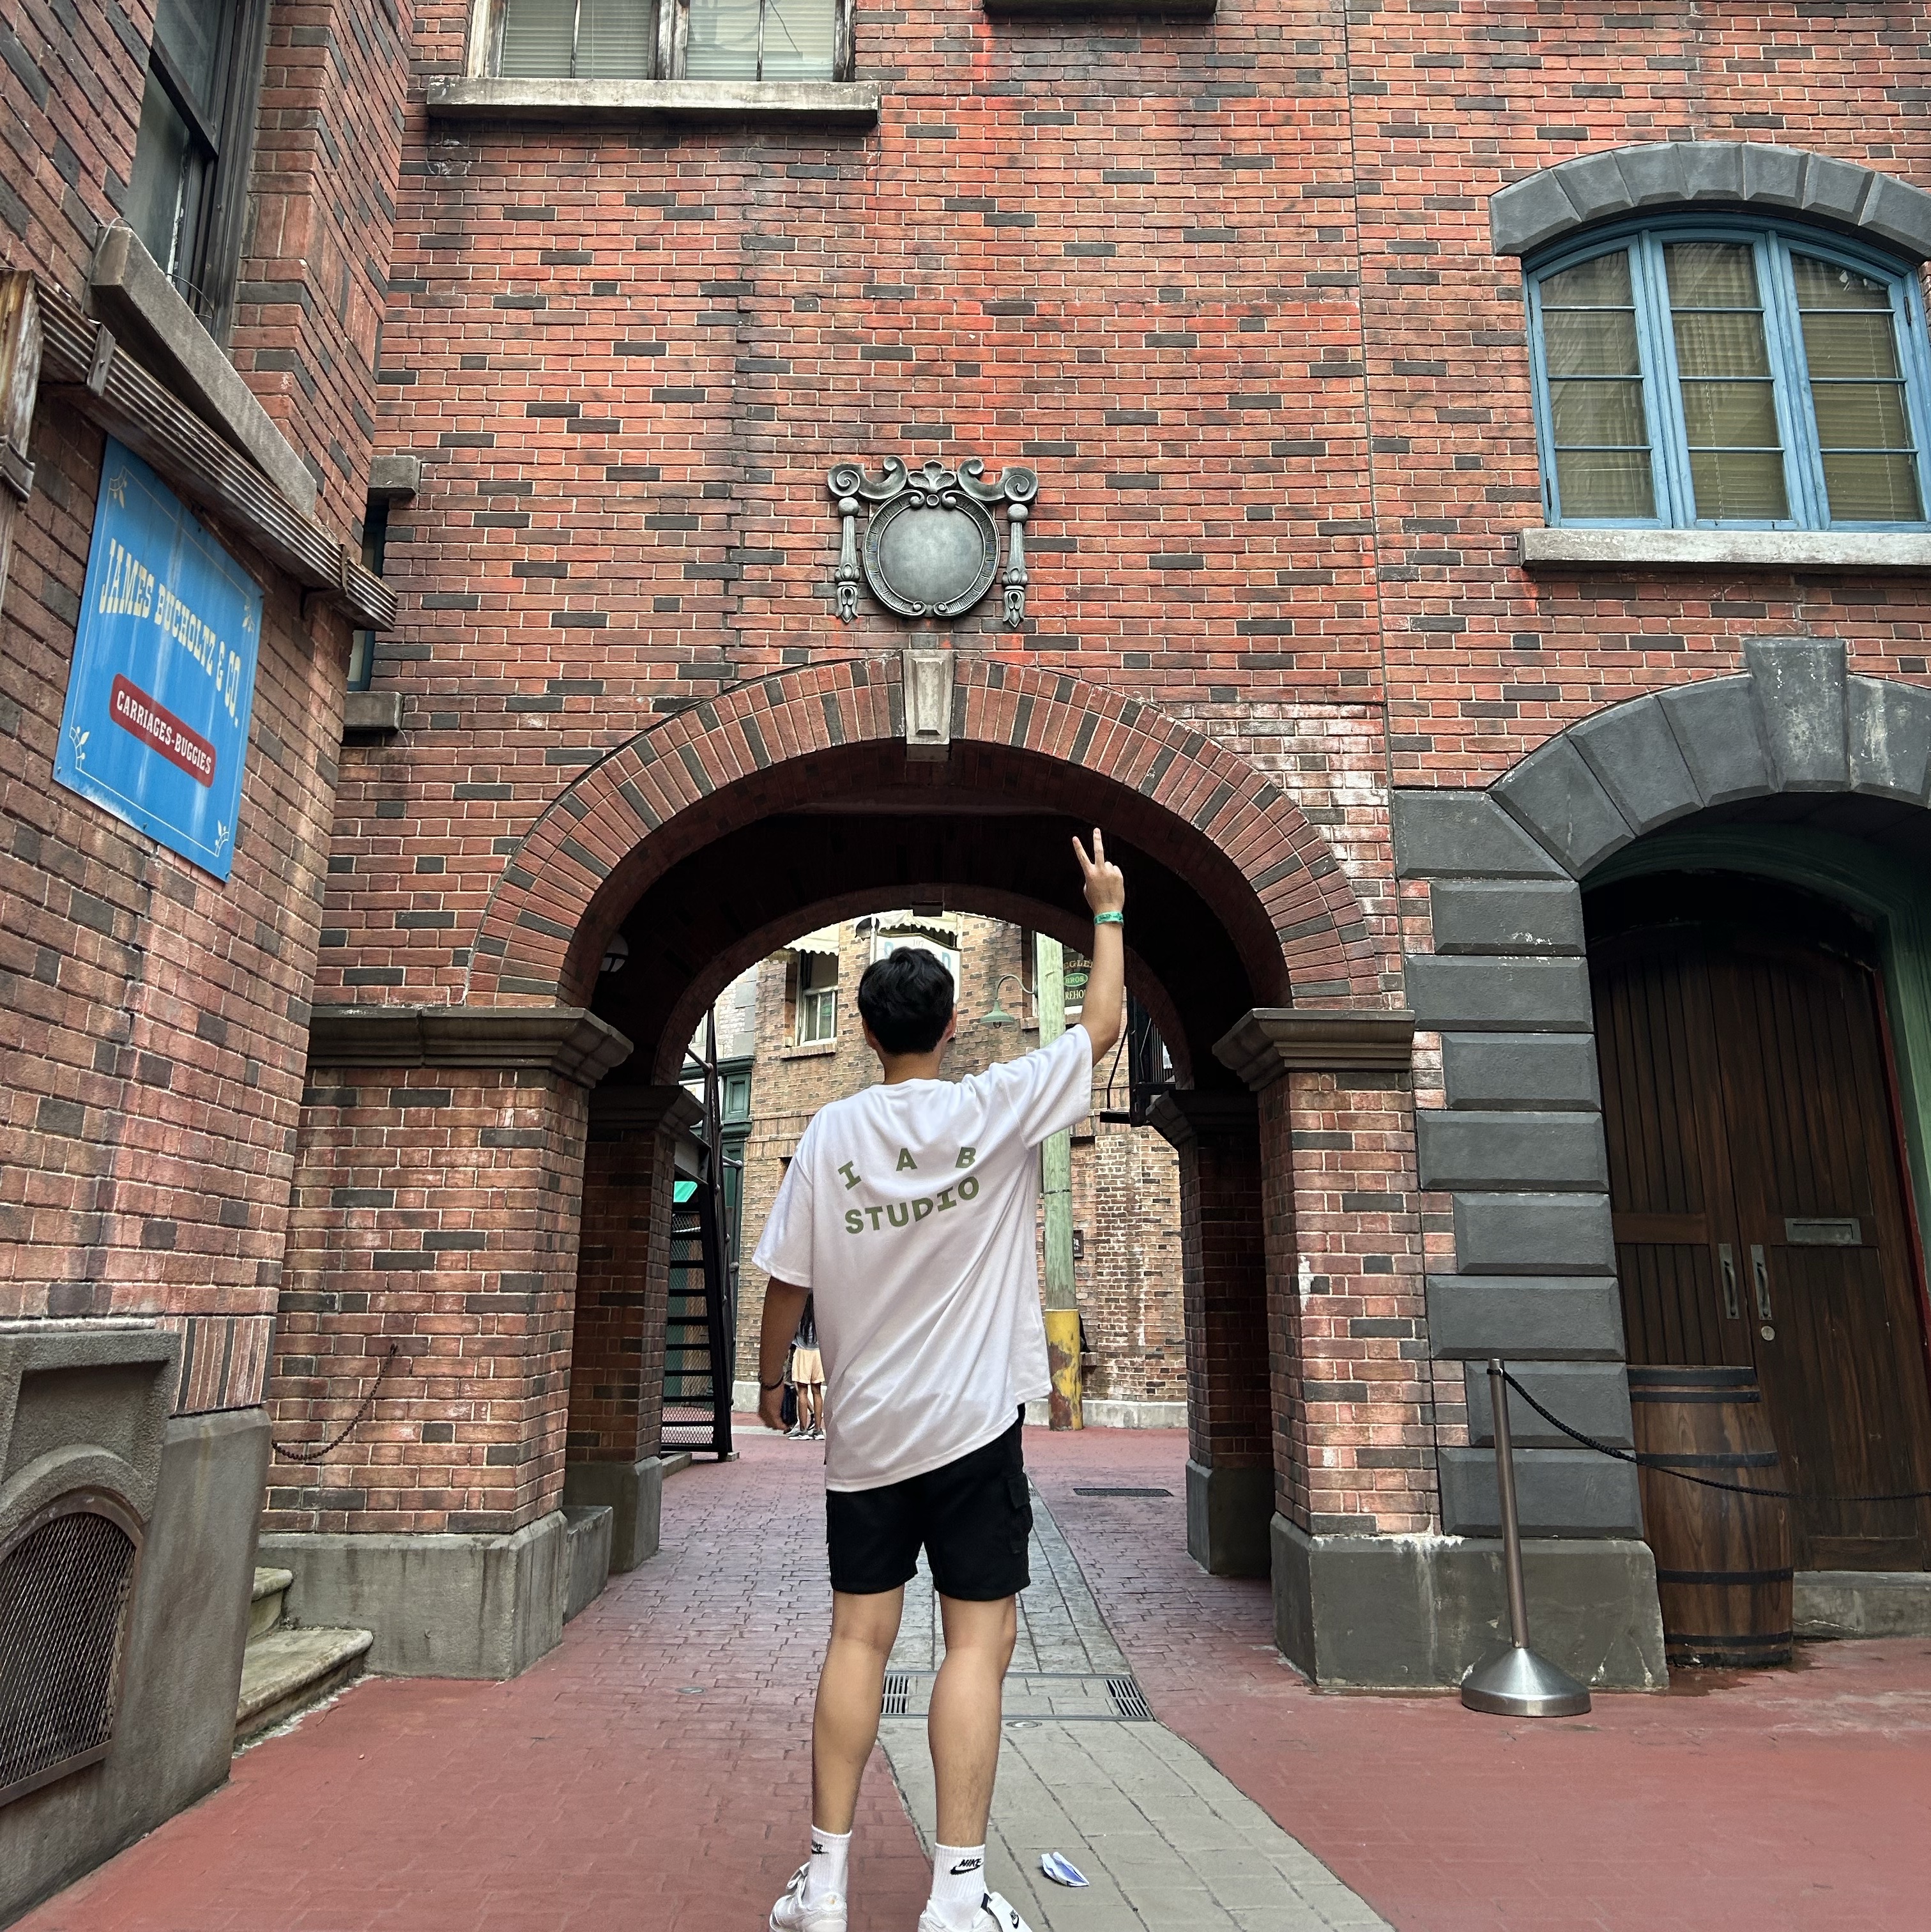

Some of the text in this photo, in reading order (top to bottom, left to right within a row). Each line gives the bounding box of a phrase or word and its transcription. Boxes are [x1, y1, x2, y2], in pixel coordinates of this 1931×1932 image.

[99, 537, 241, 728] JAMES BUCHOLTZ & CO.
[116, 690, 211, 774] CARRIAGES-BUGGIES
[844, 1176, 979, 1234] STUDIO
[958, 1857, 982, 1867] NIKE
